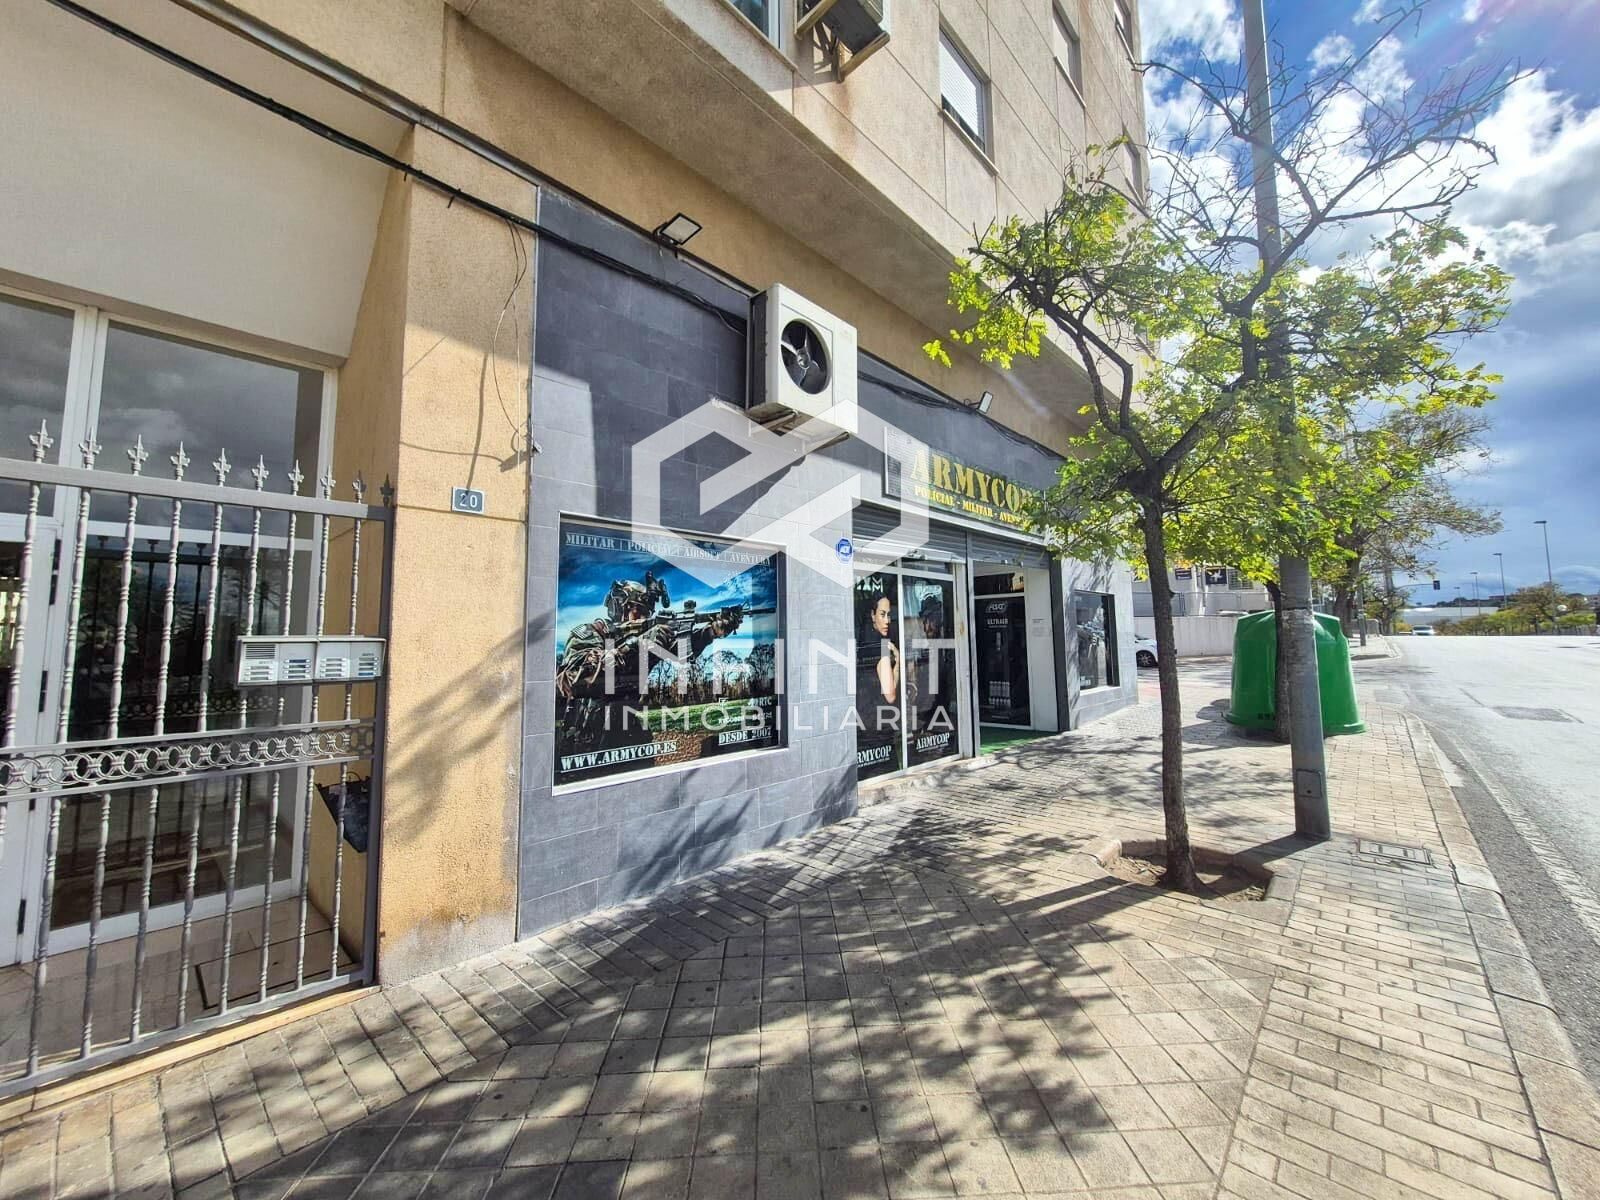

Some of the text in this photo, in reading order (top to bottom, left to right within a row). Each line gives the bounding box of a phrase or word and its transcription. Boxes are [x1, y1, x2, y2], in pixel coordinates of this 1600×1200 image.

[460, 492, 478, 508] 20
[962, 500, 993, 517] MILITAR
[565, 533, 615, 549] MILITAR
[719, 727, 772, 745] DESDE 2007
[916, 732, 950, 750] ARMYCOP
[560, 741, 678, 771] WWW.ARMYCOP.ES
